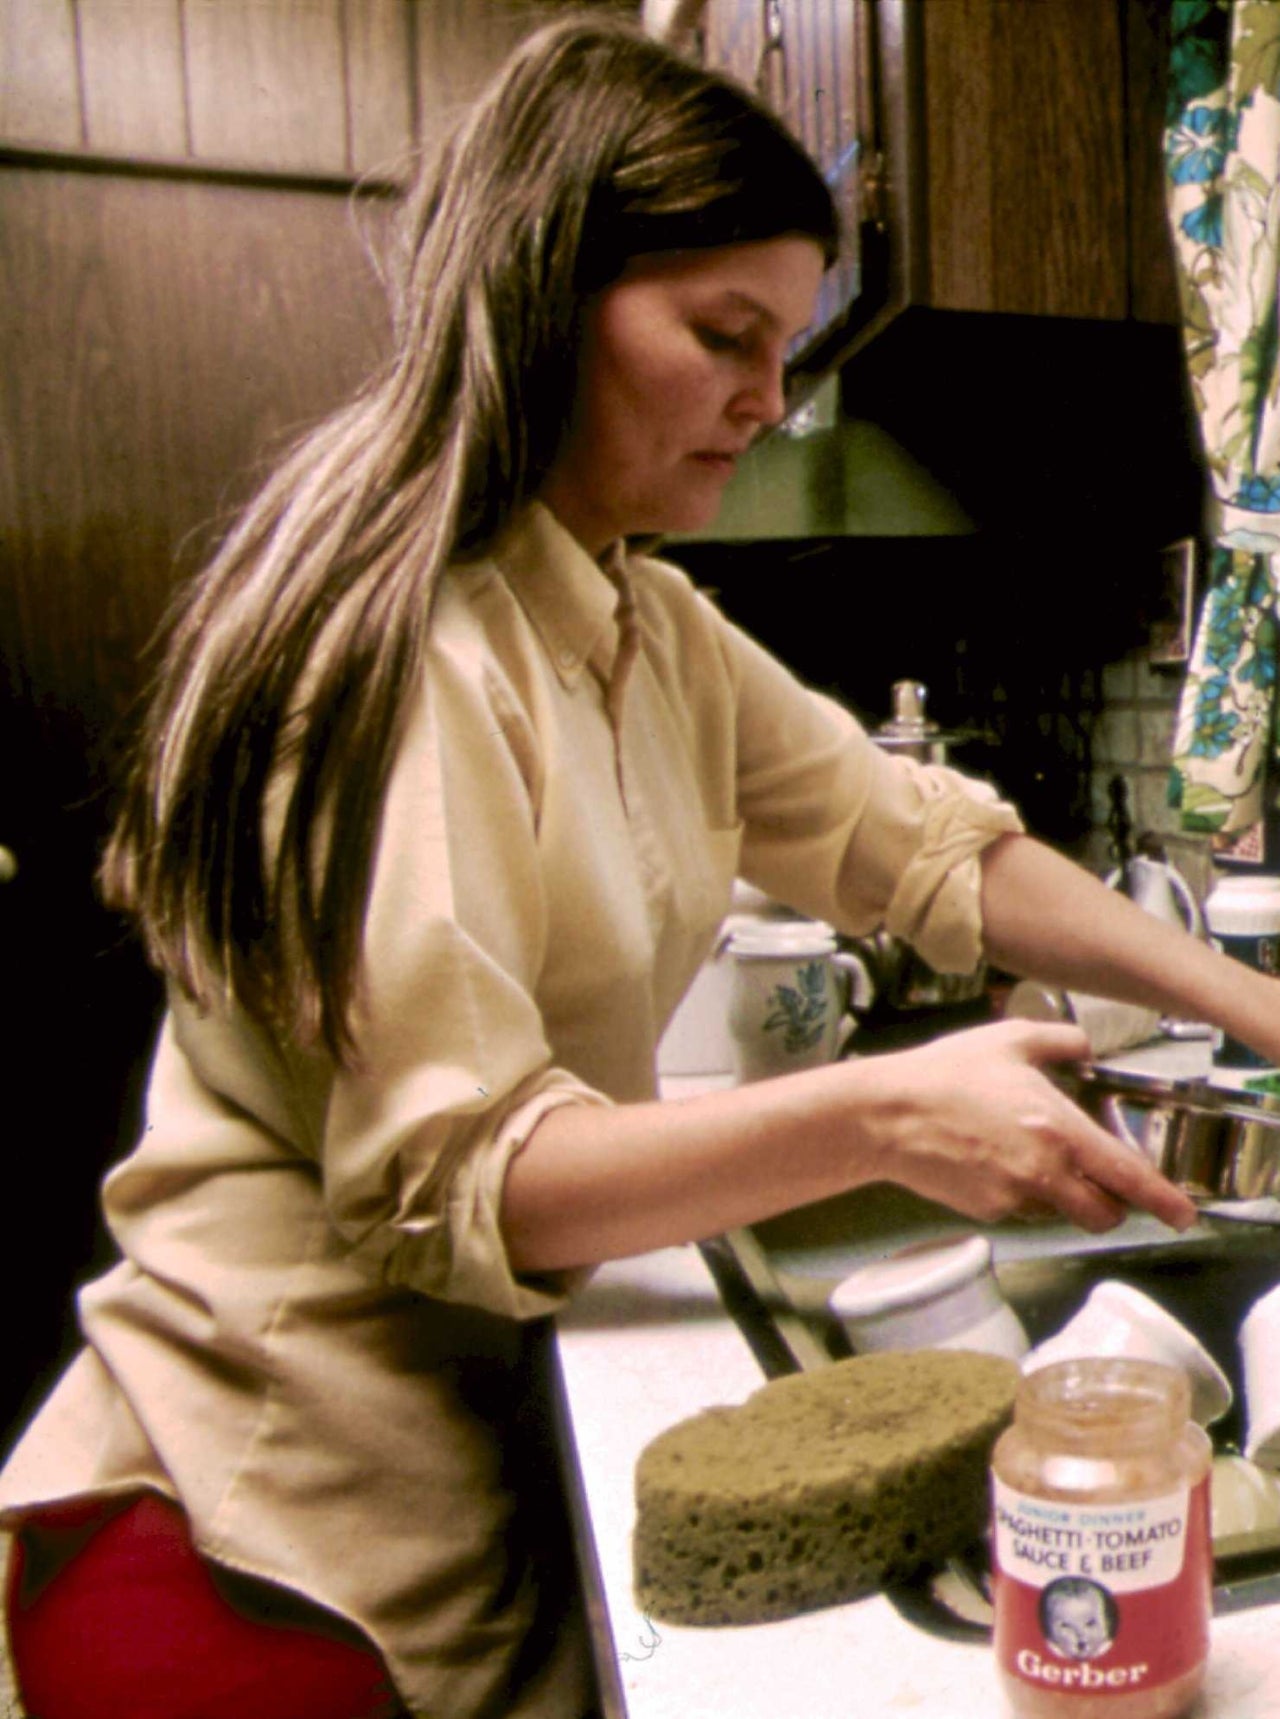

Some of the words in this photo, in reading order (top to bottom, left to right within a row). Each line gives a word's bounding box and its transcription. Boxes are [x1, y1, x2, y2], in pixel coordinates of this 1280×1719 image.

[1079, 1509, 1147, 1527] DINNER
[1094, 1516, 1183, 1551] TOMATO
[1013, 1538, 1069, 1570] SAUCE
[1101, 1548, 1153, 1573] BEEF
[1017, 1648, 1149, 1687] Gerber
